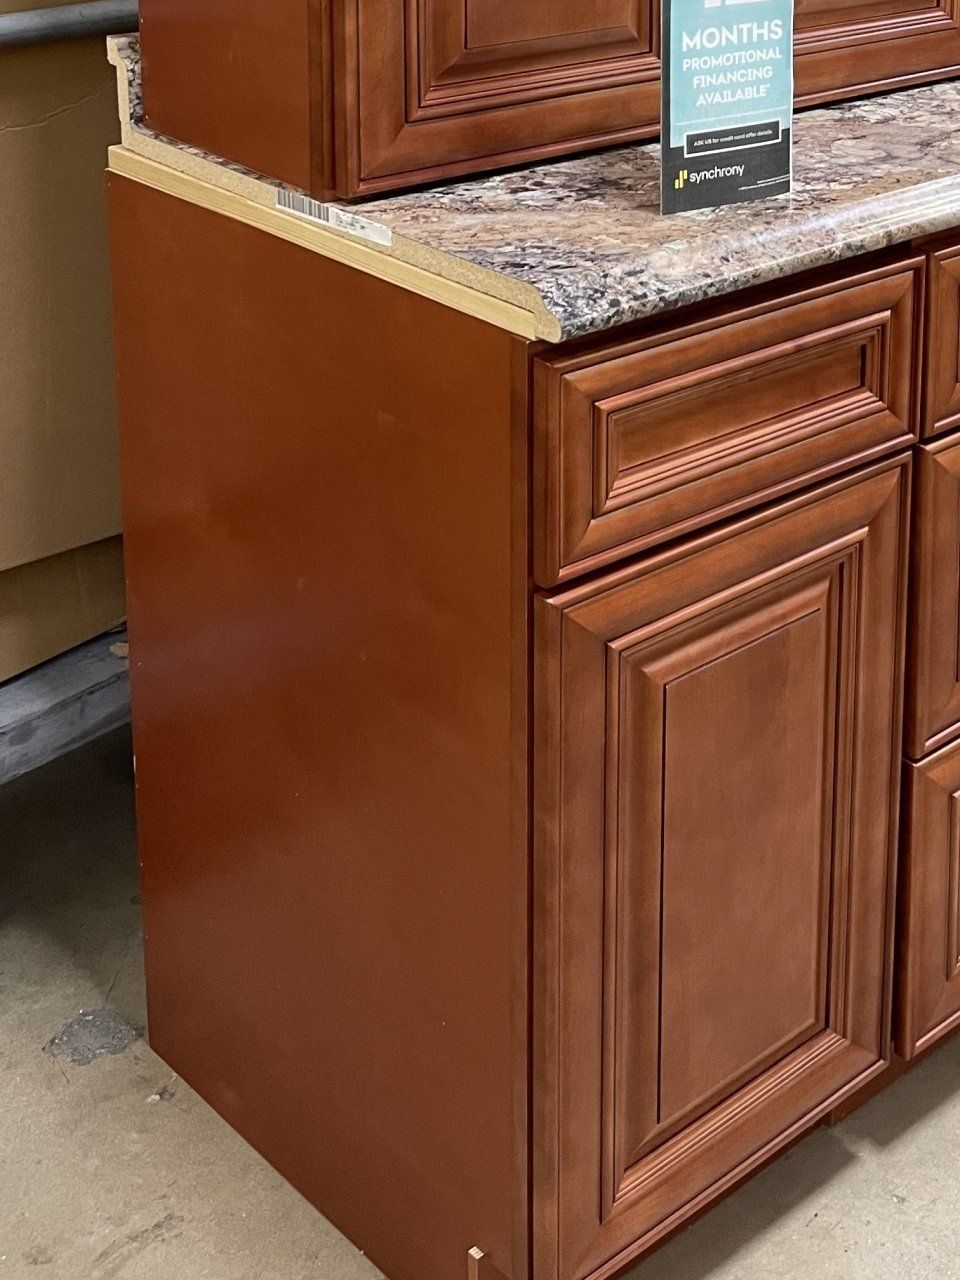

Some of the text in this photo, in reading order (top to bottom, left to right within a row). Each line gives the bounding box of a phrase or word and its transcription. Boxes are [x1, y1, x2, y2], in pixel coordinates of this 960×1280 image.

[681, 19, 784, 52] MONTHS
[682, 46, 783, 72] PROMOTIONAL
[693, 66, 774, 89] FINANCING
[689, 164, 745, 184] synchrony
